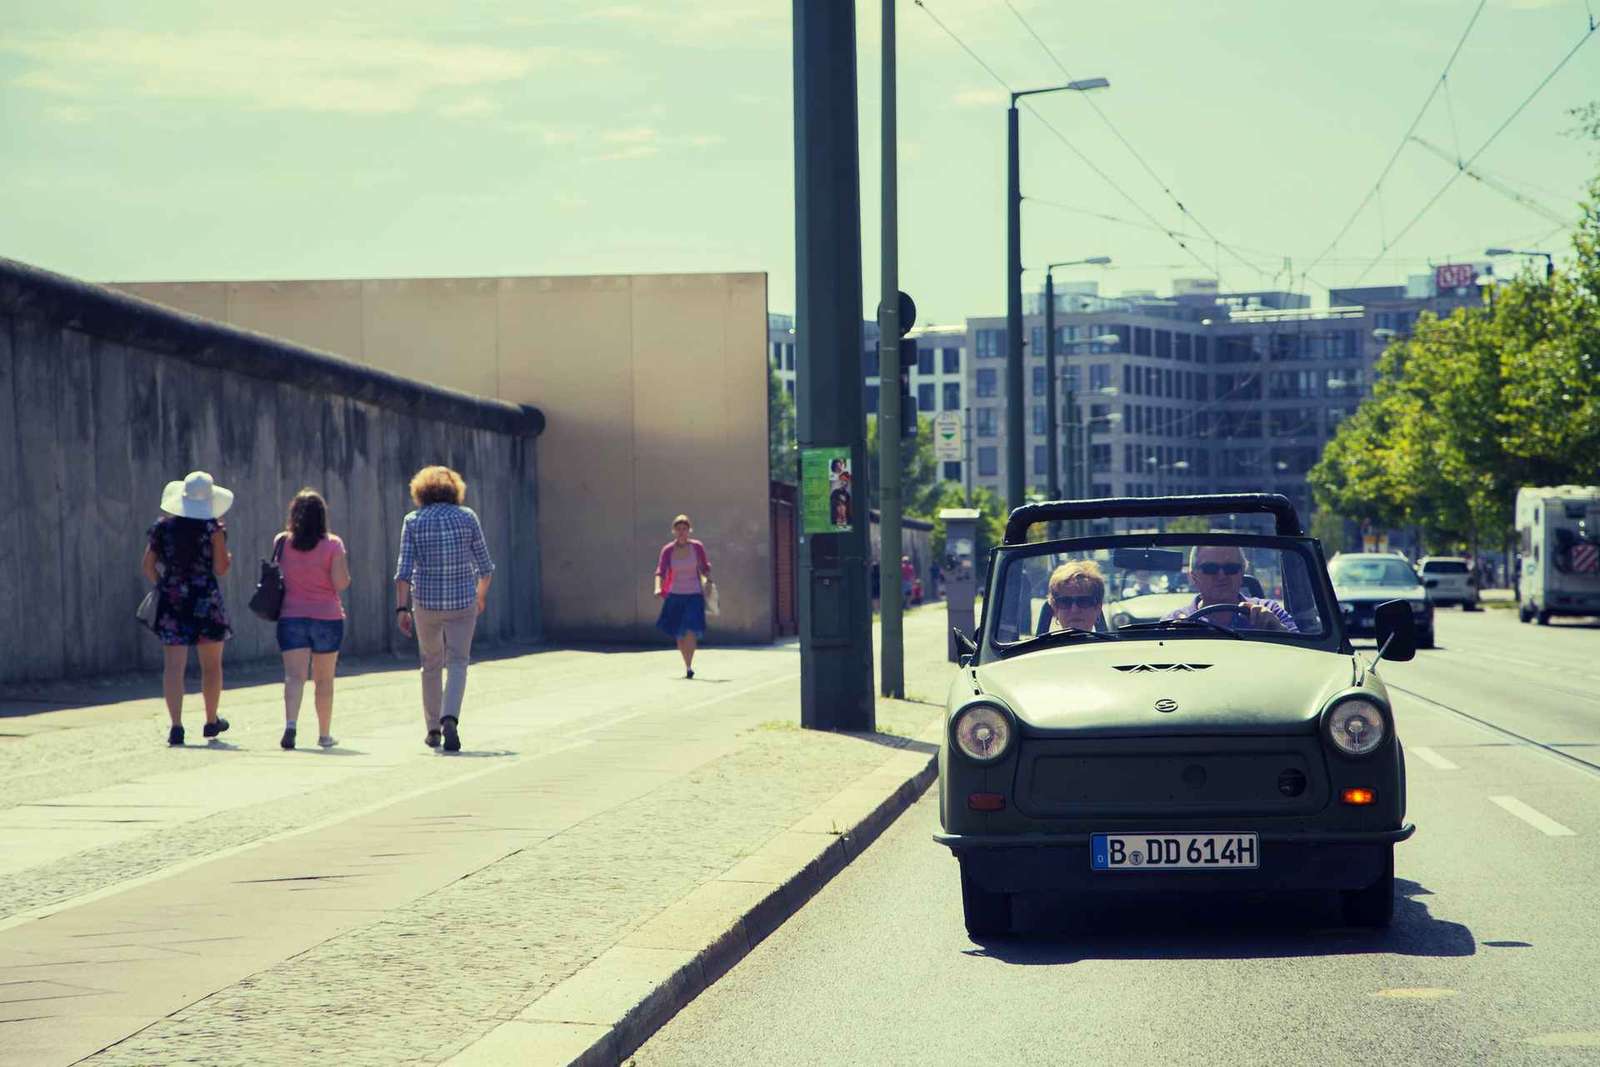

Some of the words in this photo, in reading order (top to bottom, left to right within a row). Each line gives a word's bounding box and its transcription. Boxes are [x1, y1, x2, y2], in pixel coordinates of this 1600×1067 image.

[1110, 839, 1127, 865] B
[1146, 839, 1181, 865] DD
[1187, 838, 1255, 865] 614H
